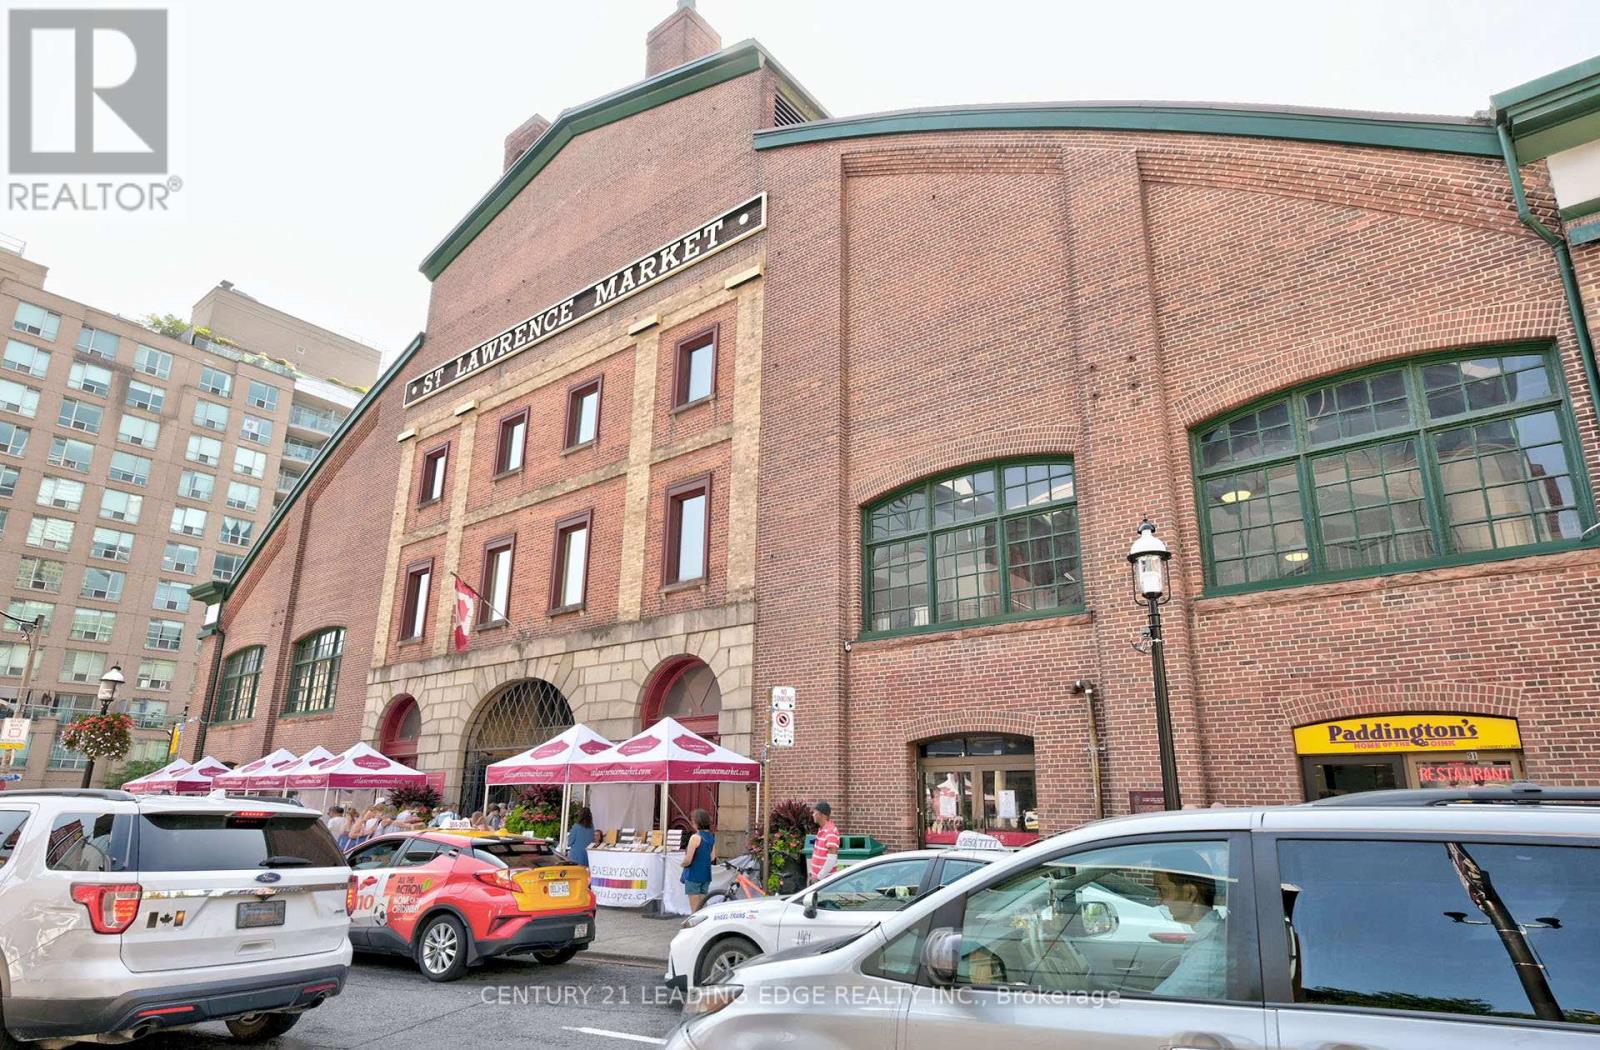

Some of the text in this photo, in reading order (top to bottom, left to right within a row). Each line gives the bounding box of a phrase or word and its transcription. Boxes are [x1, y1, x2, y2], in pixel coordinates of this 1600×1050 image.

[455, 299, 574, 378] LAWRENCE
[594, 219, 723, 307] MARKET
[1328, 719, 1478, 746] Paddington's
[1419, 767, 1512, 782] RESTAURANT
[620, 867, 648, 877] DESIGN
[396, 884, 423, 895] ACTION
